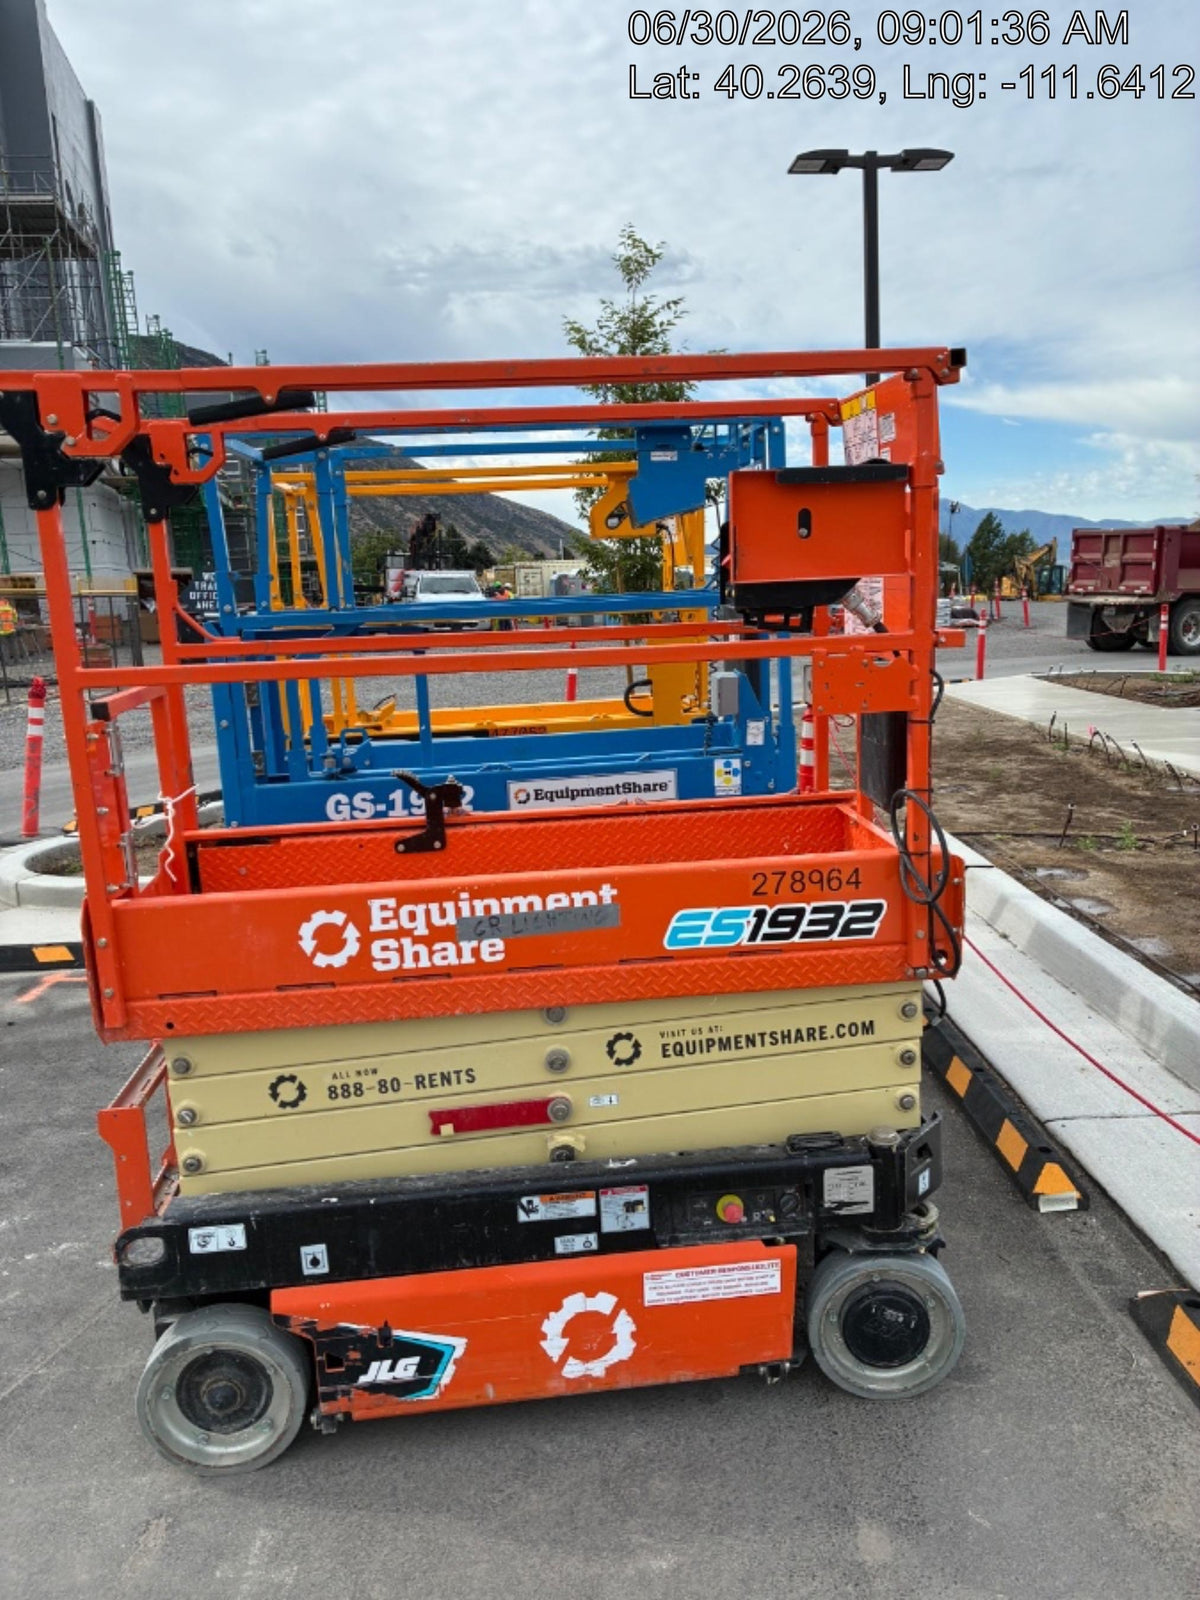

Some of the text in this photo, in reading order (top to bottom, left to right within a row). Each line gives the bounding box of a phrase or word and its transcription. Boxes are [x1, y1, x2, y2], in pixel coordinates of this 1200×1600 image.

[325, 785, 475, 821] GS-192
[533, 781, 668, 803] EquipmentShare
[752, 867, 862, 896] 278964
[663, 899, 888, 950] ES1932
[370, 936, 505, 972] Share
[659, 1028, 686, 1039] VISIT
[691, 1027, 703, 1036] US
[661, 1020, 876, 1059] EQUIPMENTSHARE.COM
[327, 1067, 477, 1101] 888-80-RENTS
[357, 1355, 422, 1385] JLG
